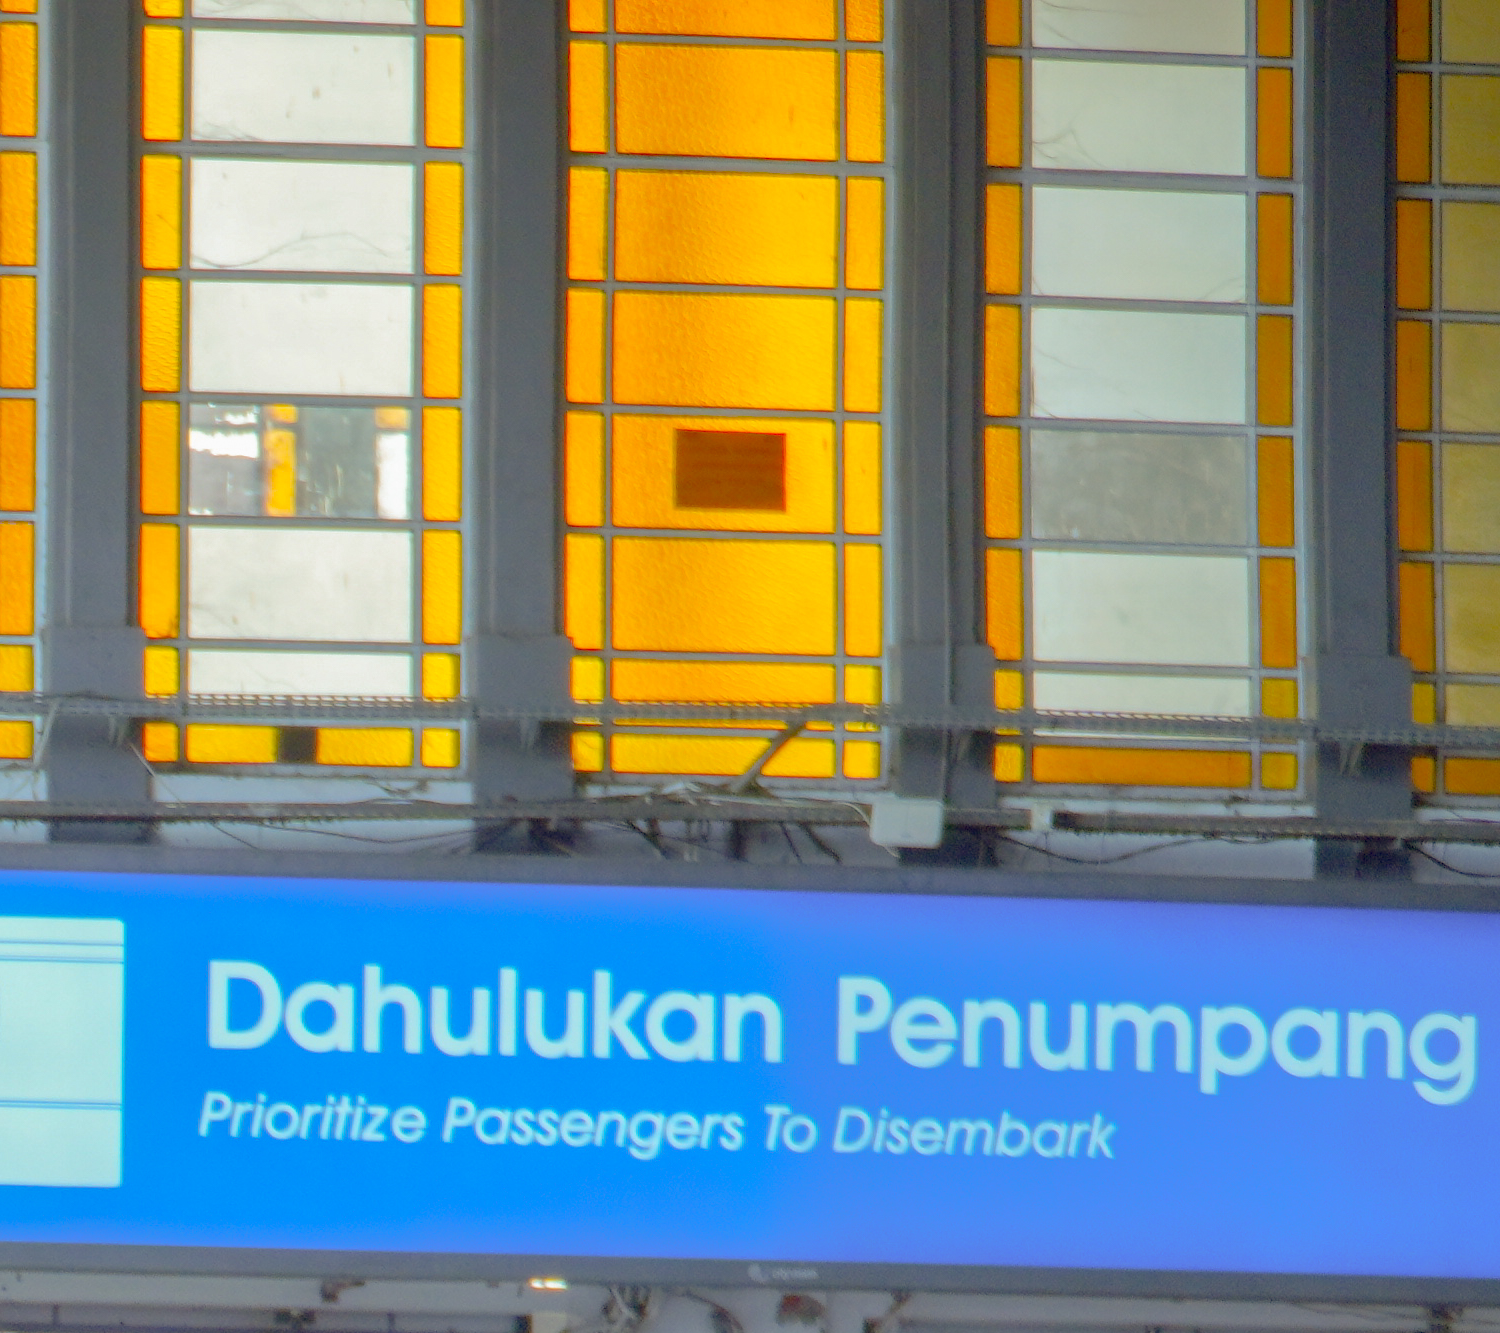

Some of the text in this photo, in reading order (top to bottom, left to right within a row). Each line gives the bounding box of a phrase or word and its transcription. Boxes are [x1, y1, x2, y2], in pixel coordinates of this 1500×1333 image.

[206, 960, 1477, 1107] Dahulukan Penumpang
[198, 1092, 1118, 1161] Prioritize Passengers To Disembark
